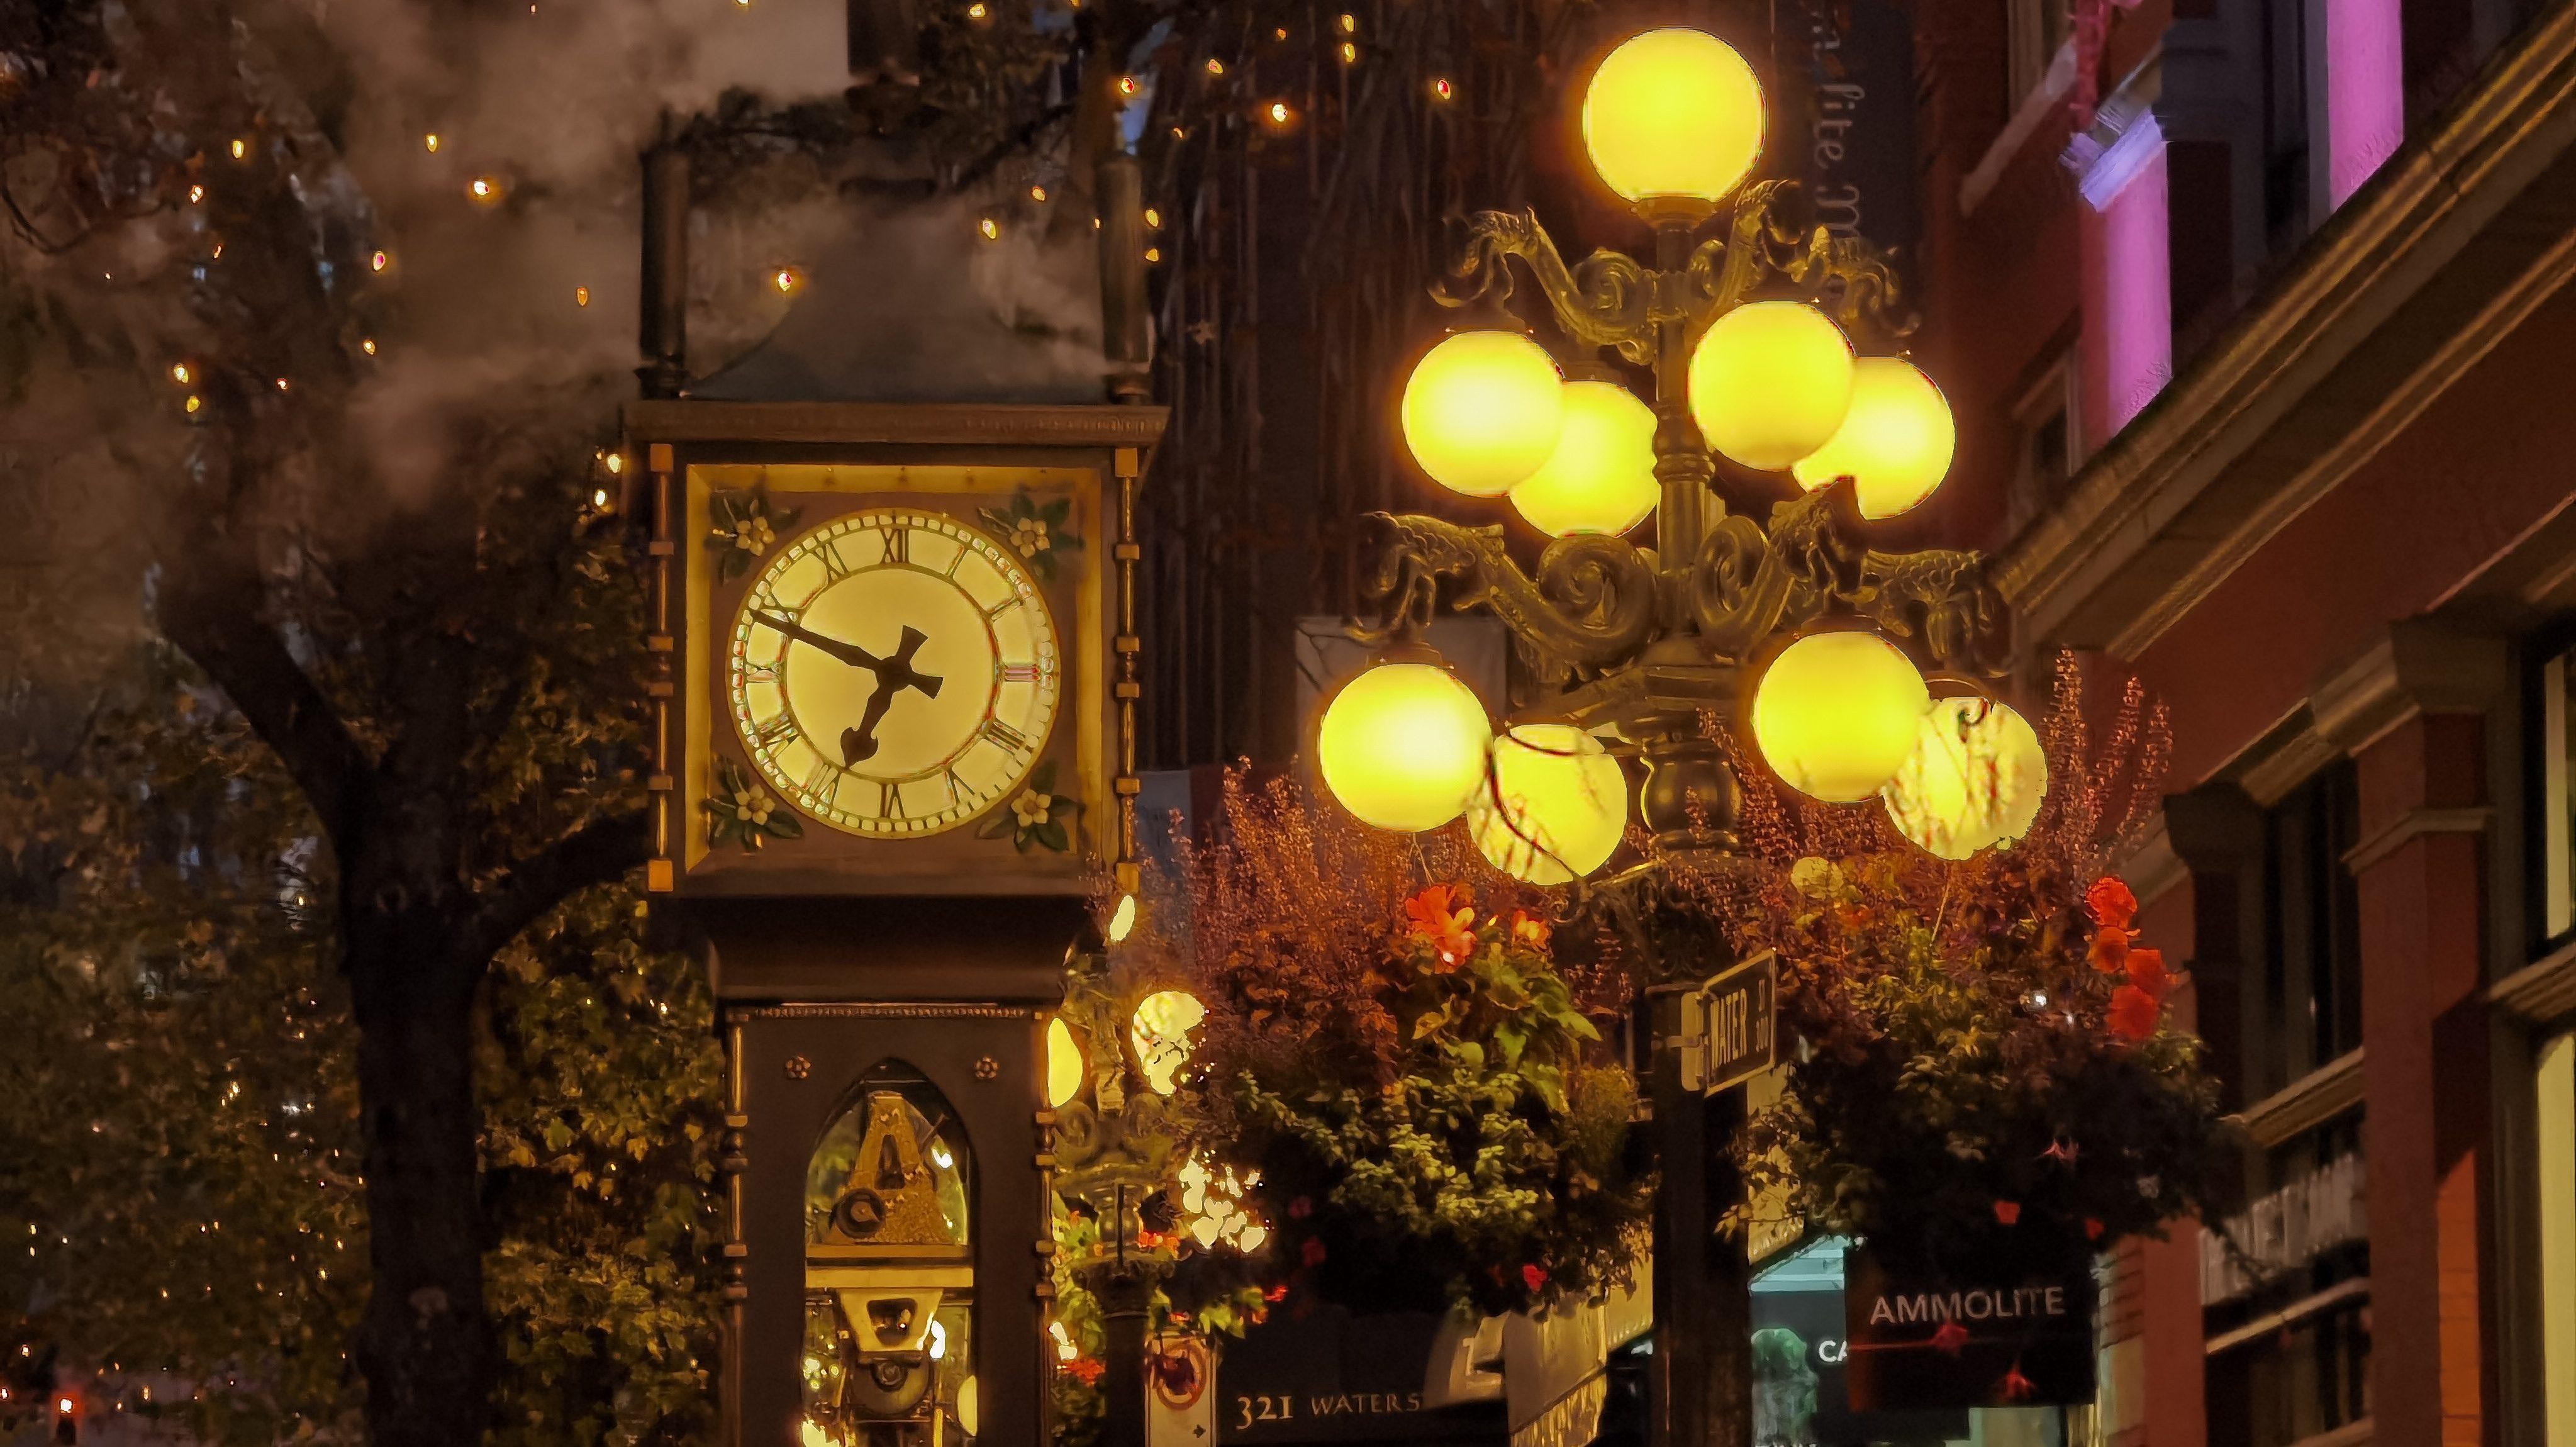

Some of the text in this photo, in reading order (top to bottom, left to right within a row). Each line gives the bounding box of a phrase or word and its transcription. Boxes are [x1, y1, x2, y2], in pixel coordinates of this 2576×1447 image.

[880, 527, 910, 563] XII
[879, 783, 906, 818] VI
[1710, 988, 1748, 1071] WATER
[1870, 1287, 2066, 1326] AMMOLITE
[1235, 1395, 1294, 1431] 321
